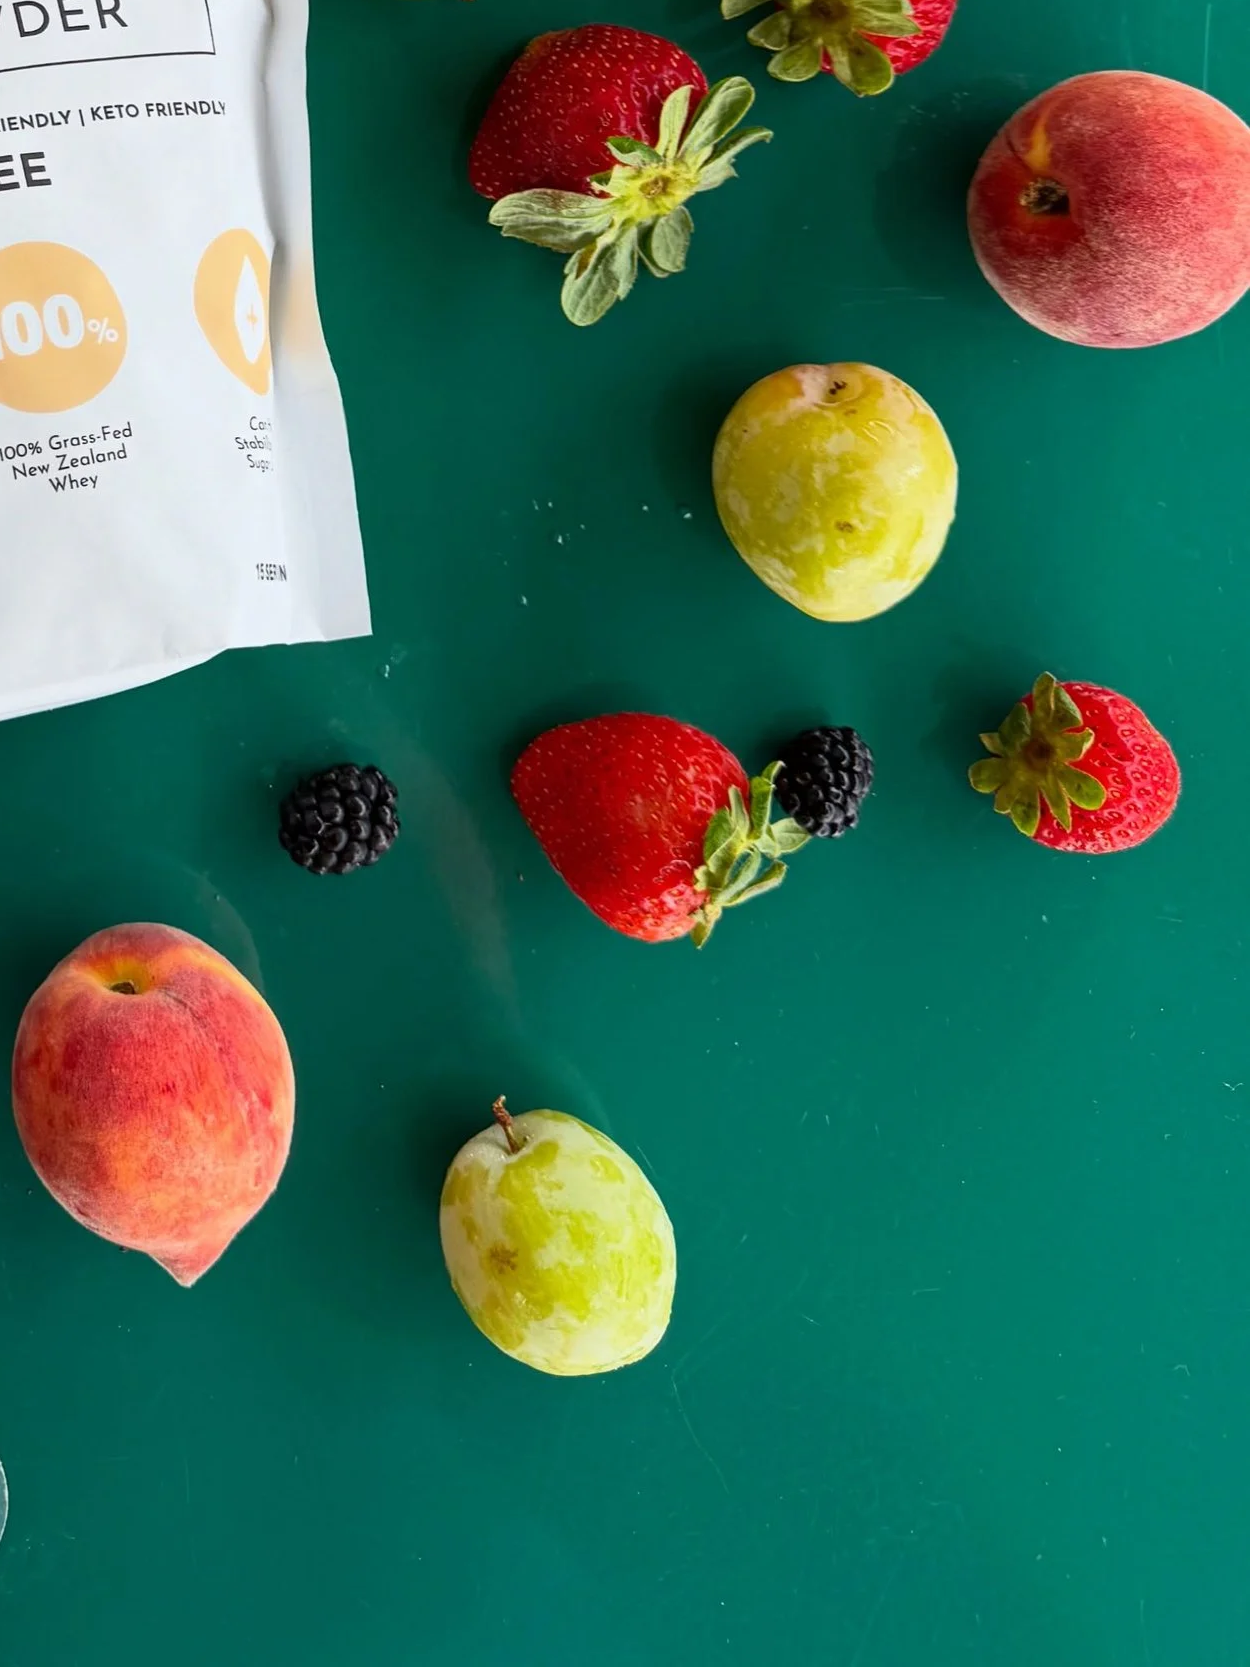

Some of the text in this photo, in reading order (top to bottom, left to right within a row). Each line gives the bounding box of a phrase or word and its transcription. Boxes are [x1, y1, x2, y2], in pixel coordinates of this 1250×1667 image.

[90, 103, 140, 122] KETO
[145, 100, 227, 119] FRIENDLY
[49, 422, 133, 450] Grass-Fed
[12, 443, 128, 480] New Zealand
[49, 474, 98, 493] Whey
